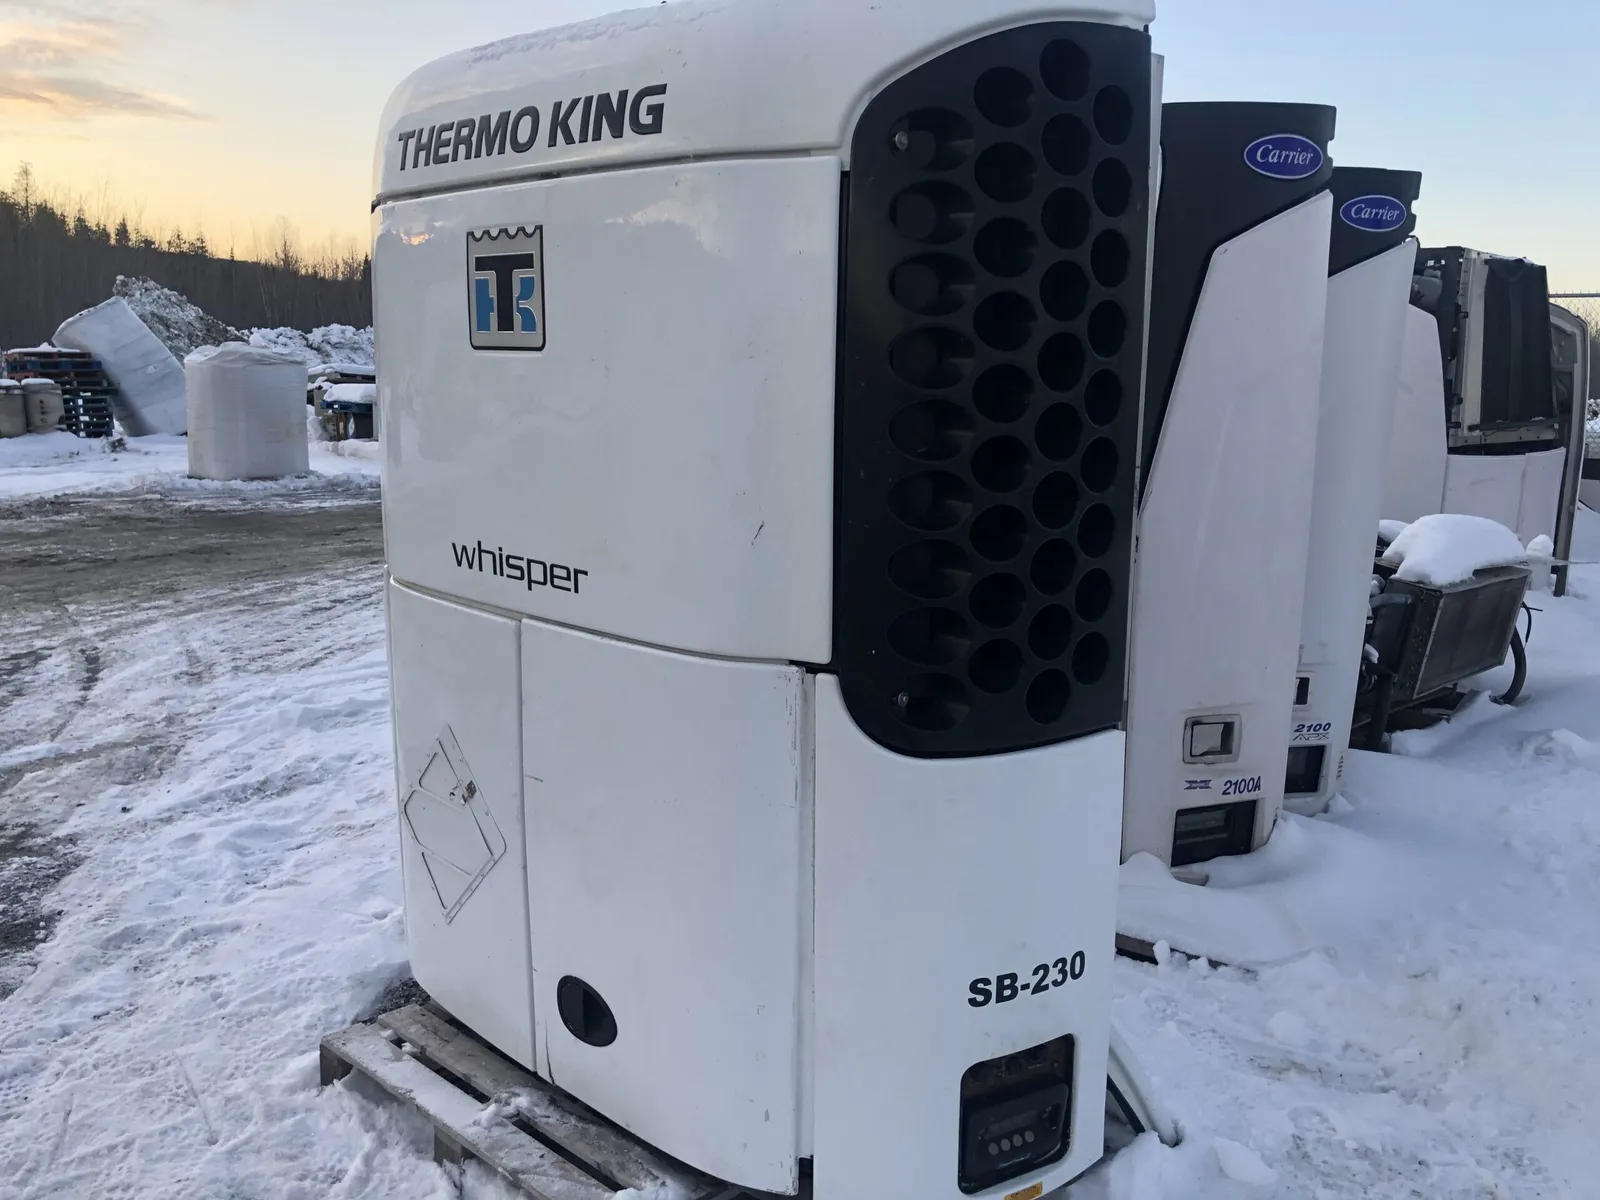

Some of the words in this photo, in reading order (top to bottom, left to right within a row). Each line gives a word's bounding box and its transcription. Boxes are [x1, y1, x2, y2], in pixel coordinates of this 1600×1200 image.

[398, 105, 540, 171] THERMO
[547, 83, 668, 148] KING
[1256, 144, 1314, 165] Carrier
[1350, 203, 1400, 221] Carrier
[451, 540, 589, 594] whisper
[1293, 722, 1332, 733] 2100
[1221, 775, 1262, 796] 2100A
[967, 950, 1086, 1008] SB-230
